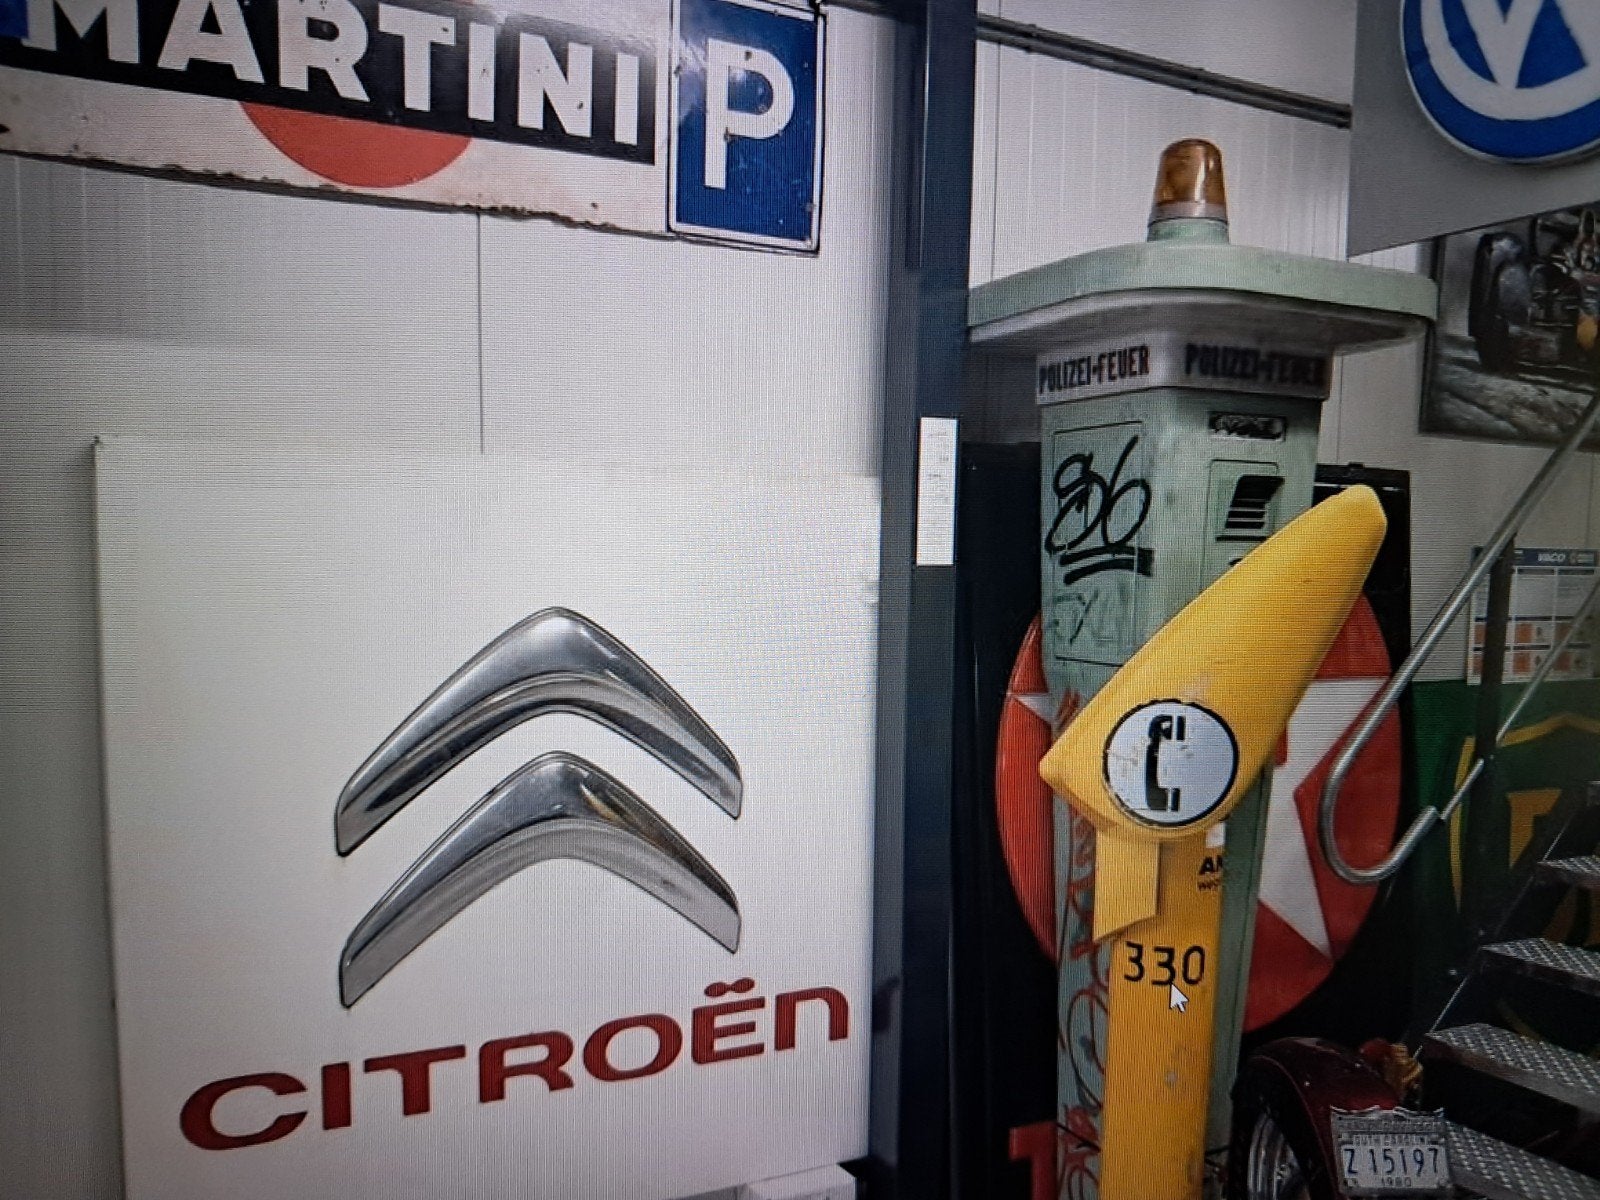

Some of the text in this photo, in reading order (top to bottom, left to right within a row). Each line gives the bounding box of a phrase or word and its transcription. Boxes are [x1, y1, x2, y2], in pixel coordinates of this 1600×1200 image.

[21, 0, 641, 147] MARTINI
[703, 37, 796, 191] P
[1123, 940, 1206, 986] 330
[1368, 1147, 1439, 1177] 15197
